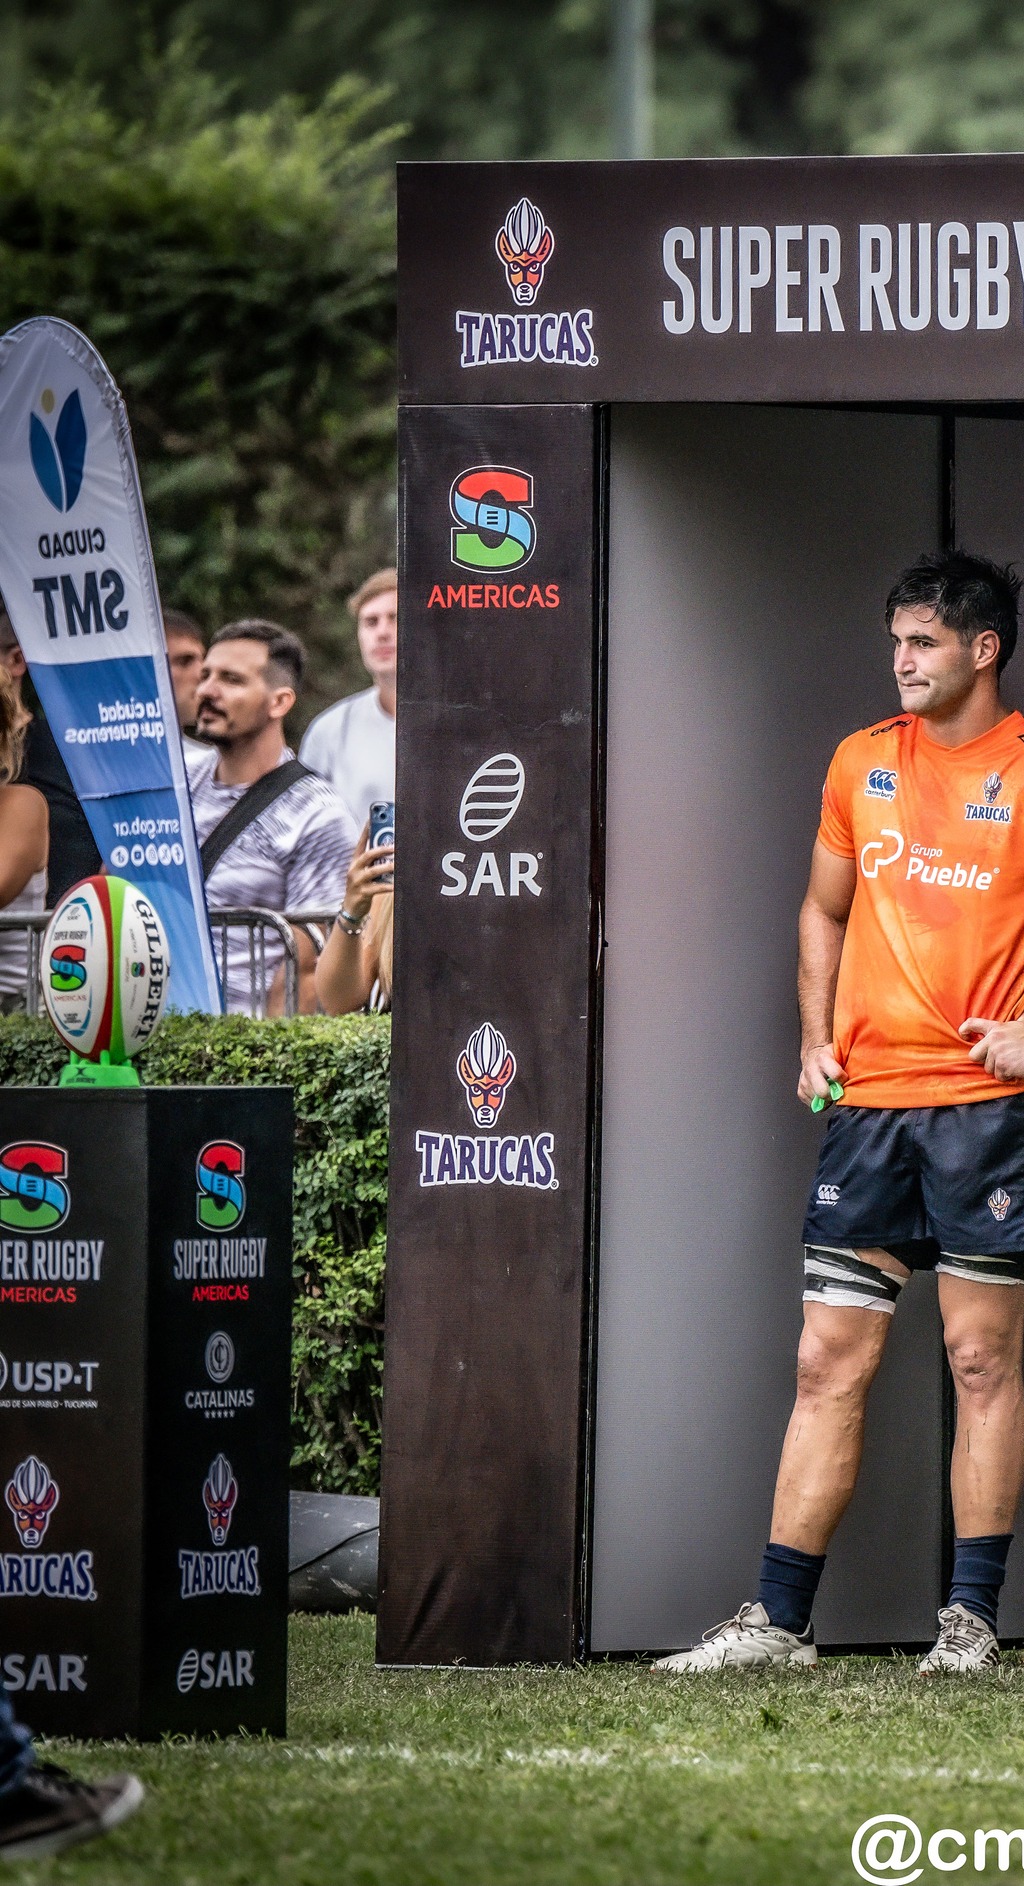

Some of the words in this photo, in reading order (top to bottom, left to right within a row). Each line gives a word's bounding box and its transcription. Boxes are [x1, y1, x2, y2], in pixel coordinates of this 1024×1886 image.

[663, 224, 844, 334] SUPER
[457, 309, 593, 367] TARUCAS
[427, 584, 560, 608] AMERICAS
[965, 803, 1010, 823] TARUCAS
[910, 843, 943, 859] Grupo
[440, 852, 543, 897] SAR
[906, 856, 993, 891] Pueble
[136, 899, 164, 1043] GILBERT
[416, 1130, 554, 1189] TARUCAS
[0, 1240, 29, 1280] ER
[32, 1239, 104, 1281] RUGBY
[173, 1239, 219, 1280] SUPER
[220, 1237, 267, 1278] RUGBY
[1, 1287, 77, 1303] MERICAS
[192, 1284, 249, 1301] AMERICAS
[12, 1400, 21, 1408] DE
[22, 1400, 36, 1408] SAN
[37, 1400, 59, 1409] PABLO
[184, 1389, 255, 1409] CATALINAS
[179, 1546, 258, 1599] TARUCAS
[3, 1654, 87, 1692] SAR
[200, 1650, 255, 1689] SAR
